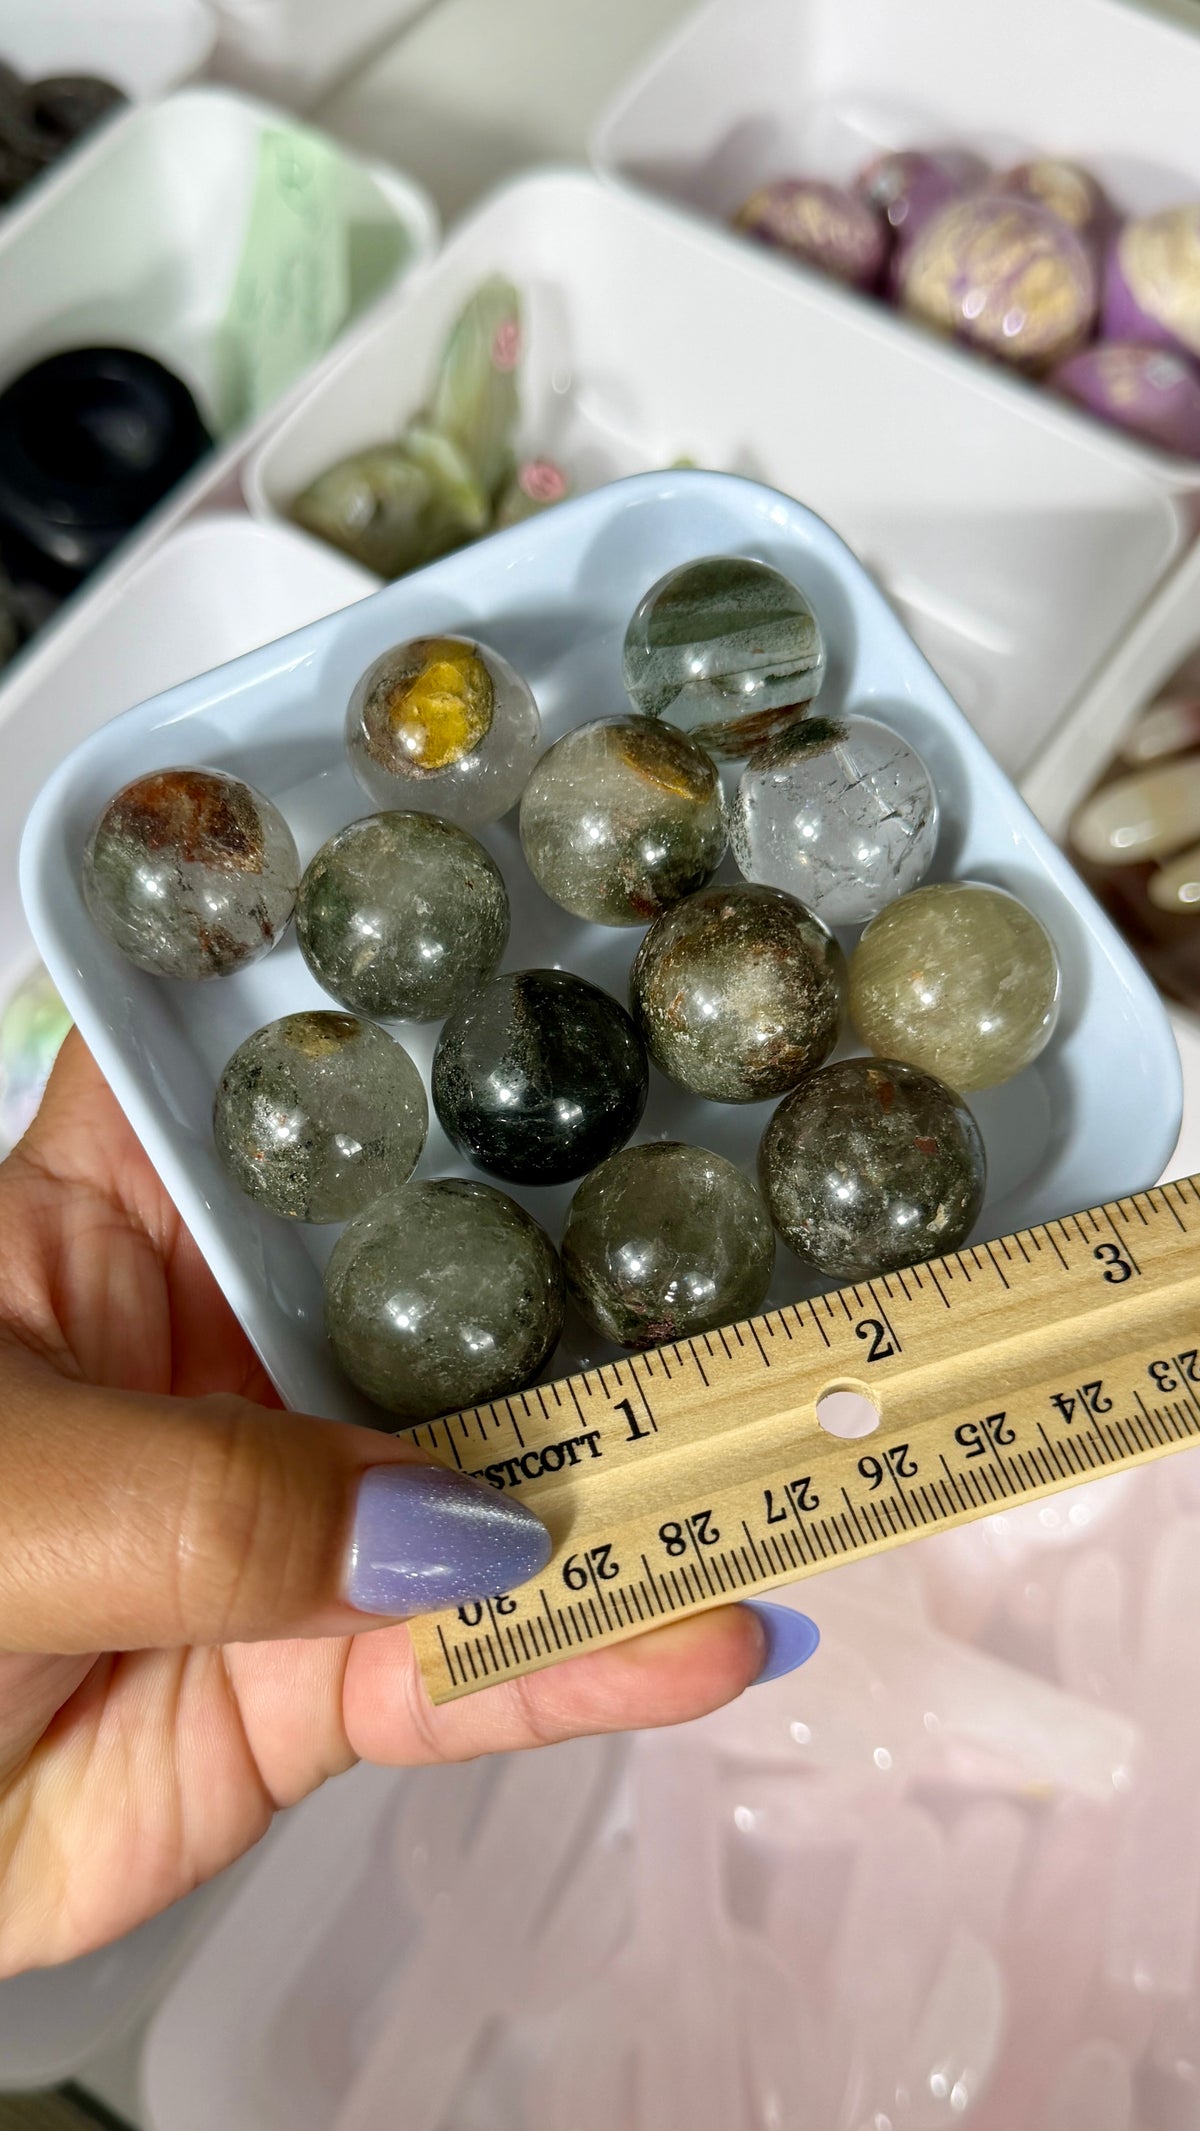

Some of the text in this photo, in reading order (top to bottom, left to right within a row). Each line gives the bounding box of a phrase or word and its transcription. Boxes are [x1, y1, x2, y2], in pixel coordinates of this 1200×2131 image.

[613, 1242, 1132, 1442] 1 2 3
[1148, 1349, 1200, 1392] 23
[1049, 1380, 1113, 1425] 24
[954, 1411, 1017, 1459] 25
[462, 1430, 602, 1490] STCOTT
[857, 1443, 918, 1490] 26
[763, 1476, 819, 1524] 27
[658, 1509, 720, 1557] 28
[562, 1543, 620, 1590] 29
